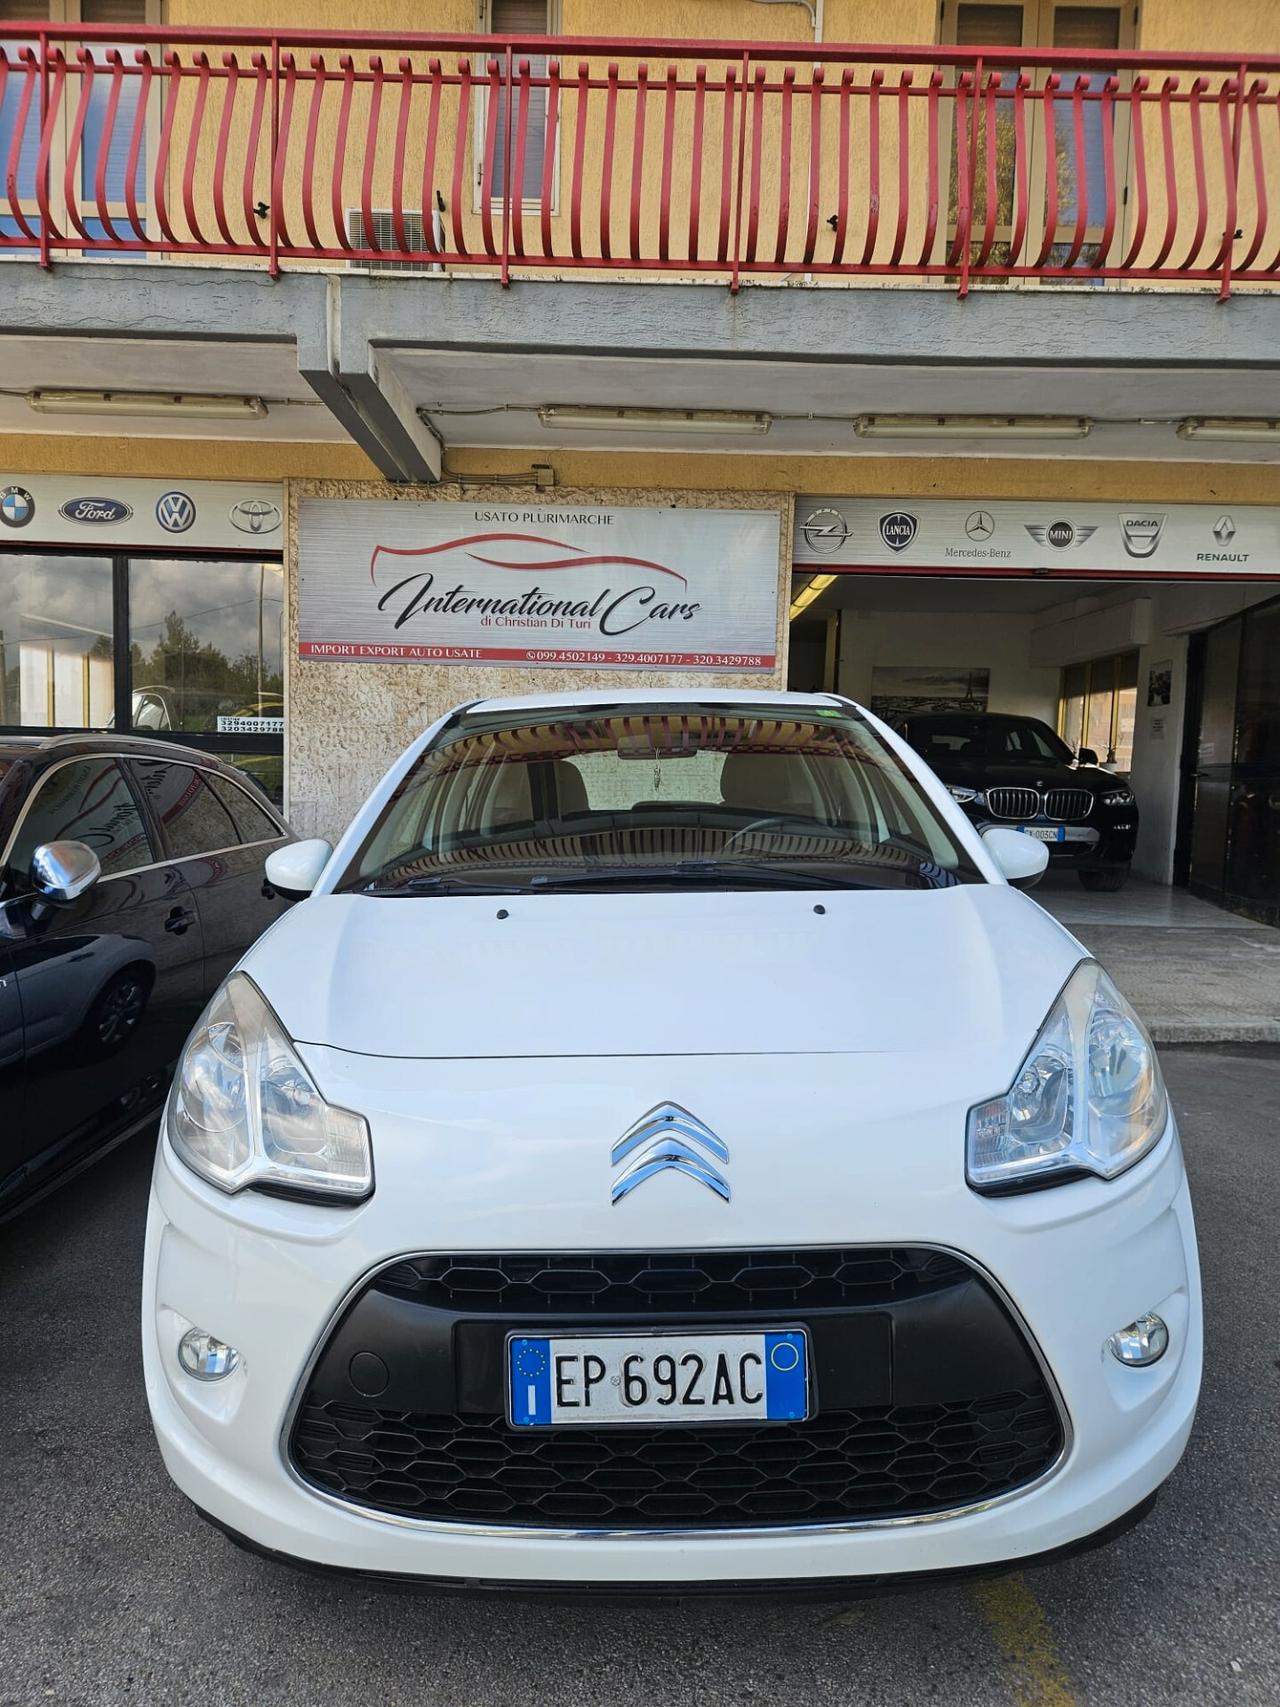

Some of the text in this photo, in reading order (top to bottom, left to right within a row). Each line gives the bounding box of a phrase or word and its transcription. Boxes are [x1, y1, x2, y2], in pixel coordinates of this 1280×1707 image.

[75, 501, 116, 520] Ford
[474, 511, 615, 525] USATO PLURIMARCHE
[1125, 519, 1159, 528] DACIA
[885, 524, 911, 536] LANCIA
[1049, 529, 1072, 540] MINI
[944, 547, 1012, 559] Mercedes-Benz
[1196, 552, 1250, 563] RENAULT
[377, 572, 703, 636] International Cars
[480, 615, 592, 630] di Christian Di Turi
[311, 644, 482, 659] IMPORT EXPORT AUTO USATE
[536, 650, 606, 662] 099.4502149
[614, 653, 683, 665] 329.4007177
[692, 655, 762, 666] 320.3429788
[555, 1353, 607, 1407] EP
[622, 1352, 764, 1406] 692AC
